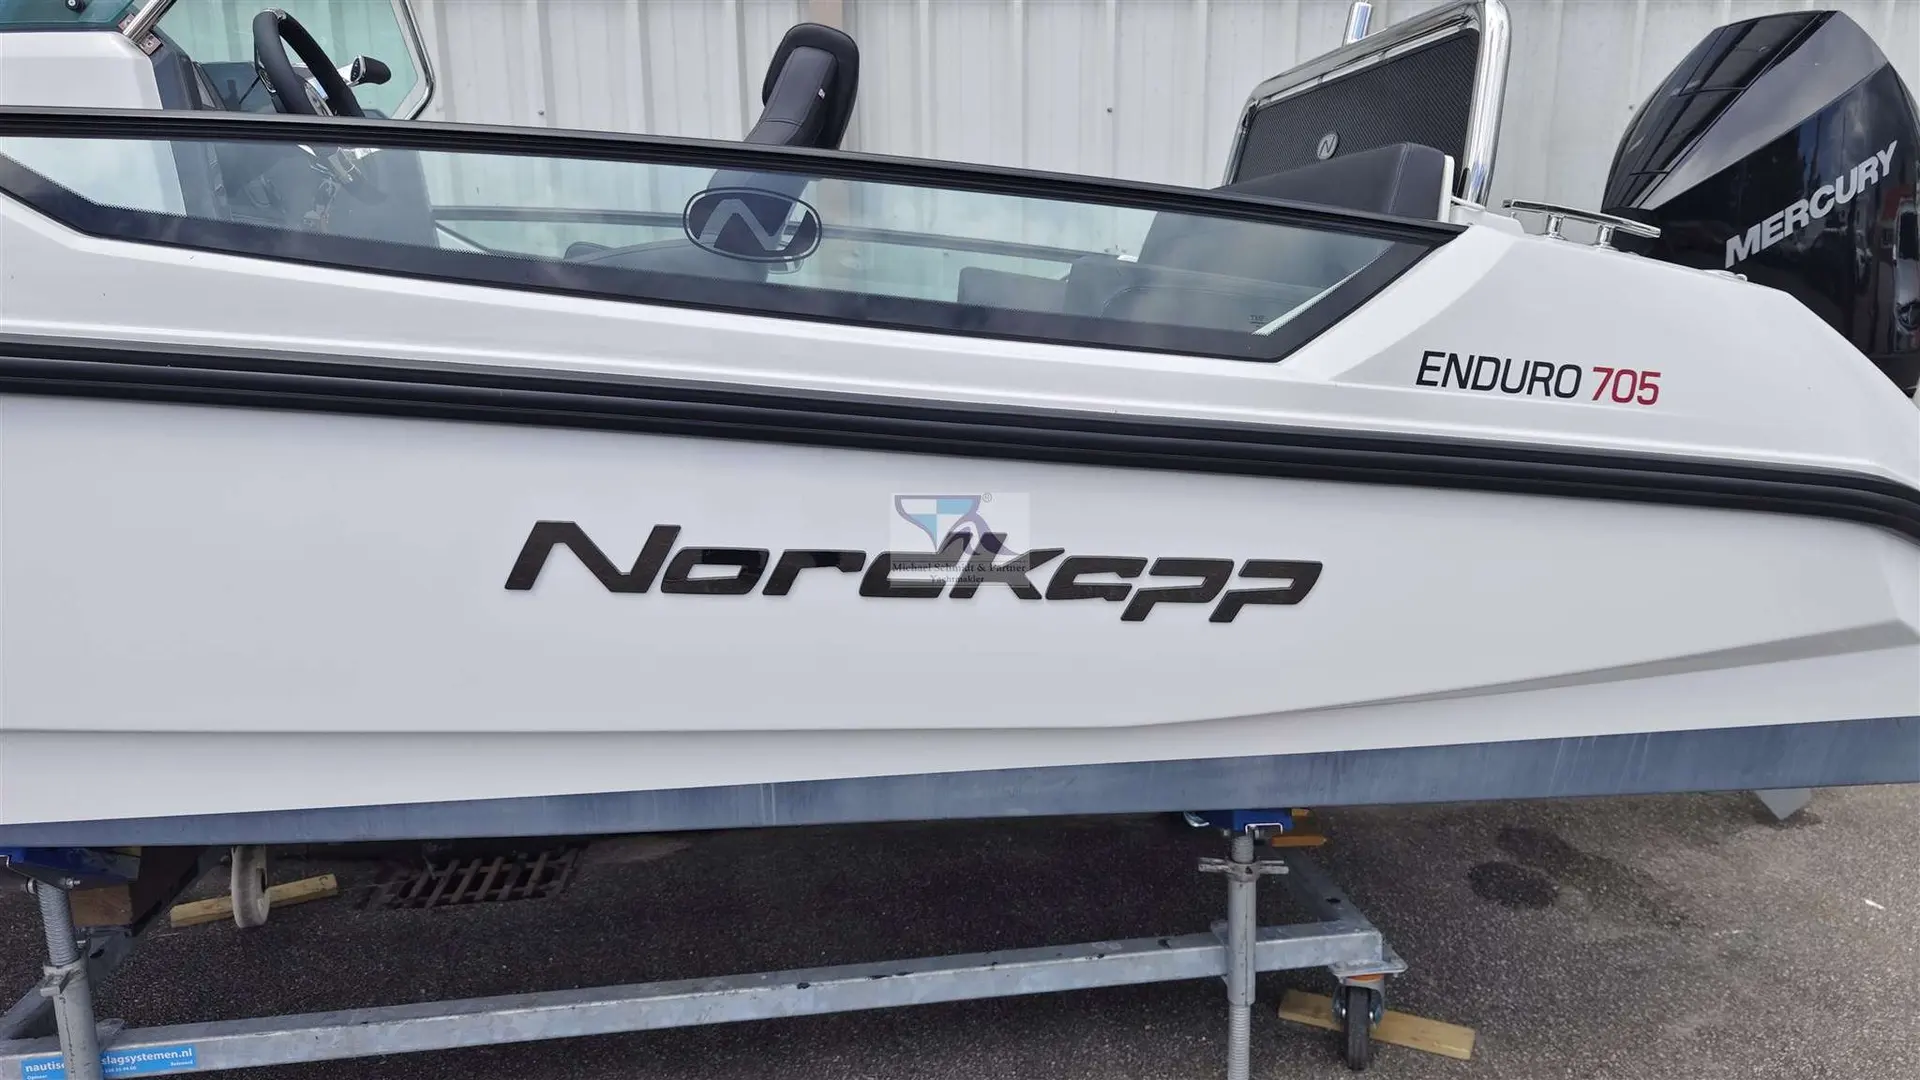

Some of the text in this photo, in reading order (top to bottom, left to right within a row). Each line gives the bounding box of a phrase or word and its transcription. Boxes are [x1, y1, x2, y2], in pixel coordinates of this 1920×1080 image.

[1725, 140, 1897, 268] MERCURY
[1416, 350, 1661, 405] ENDURO 705
[504, 520, 1323, 623] Nordkapp
